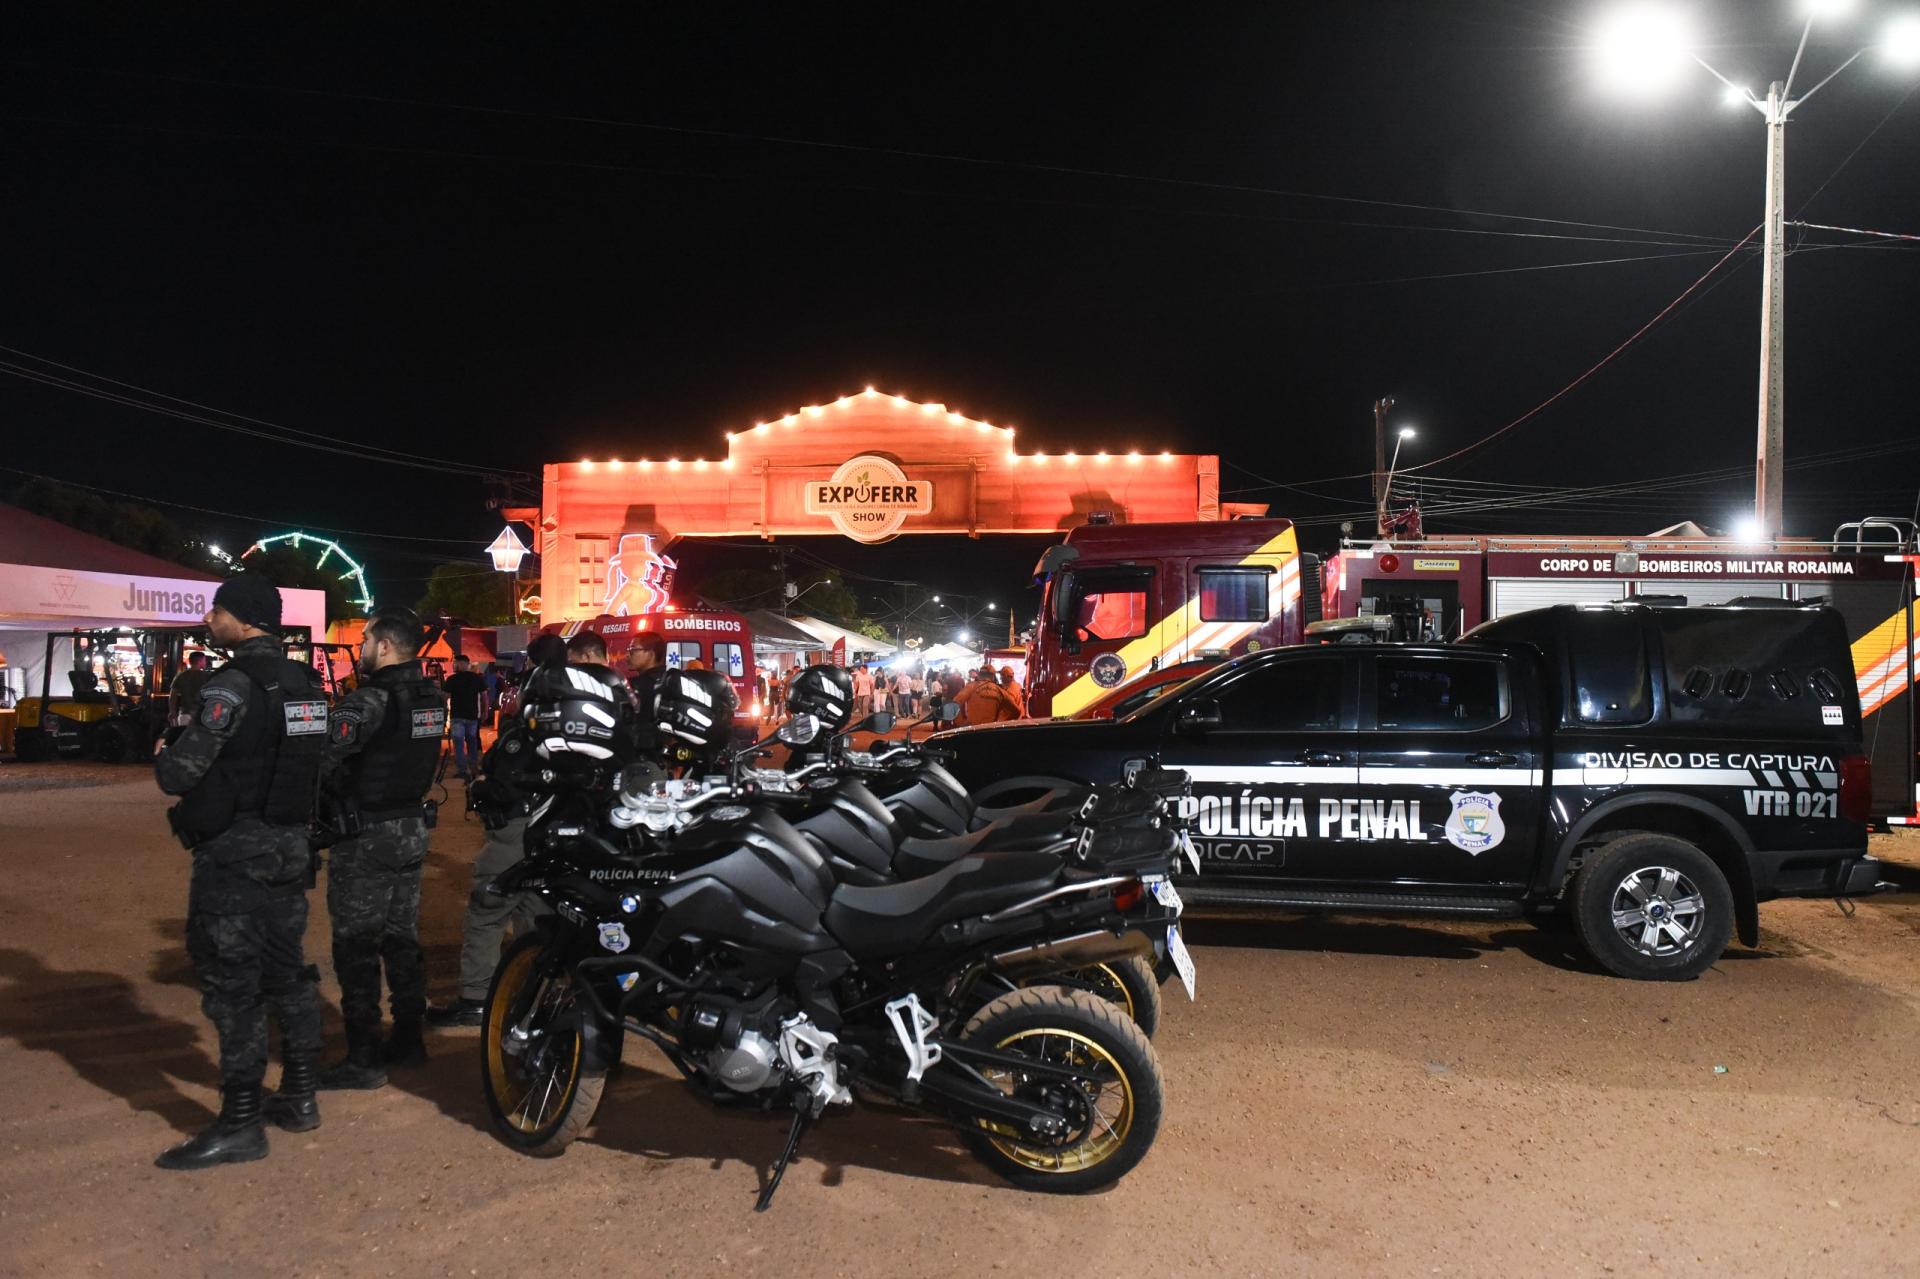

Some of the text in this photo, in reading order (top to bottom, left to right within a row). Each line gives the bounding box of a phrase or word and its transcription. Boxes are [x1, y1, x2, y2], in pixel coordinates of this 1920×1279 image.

[852, 512, 886, 522] SHOW
[1540, 559, 1854, 574] CORPO DE BOMBEIROS MILITAR RORAIMA
[123, 582, 206, 615] Jumasa
[602, 623, 631, 634] RESGATE
[664, 619, 741, 632] BOMBEIROS
[565, 721, 587, 735] 03
[1690, 753, 1720, 768] DE
[1728, 753, 1836, 772] CAPTURA
[1743, 789, 1838, 818] VTR 021
[1178, 789, 1428, 840] POLÍCIA PENAL
[1463, 839, 1486, 847] PENAL
[589, 867, 676, 880] POLÍCIA PENAL
